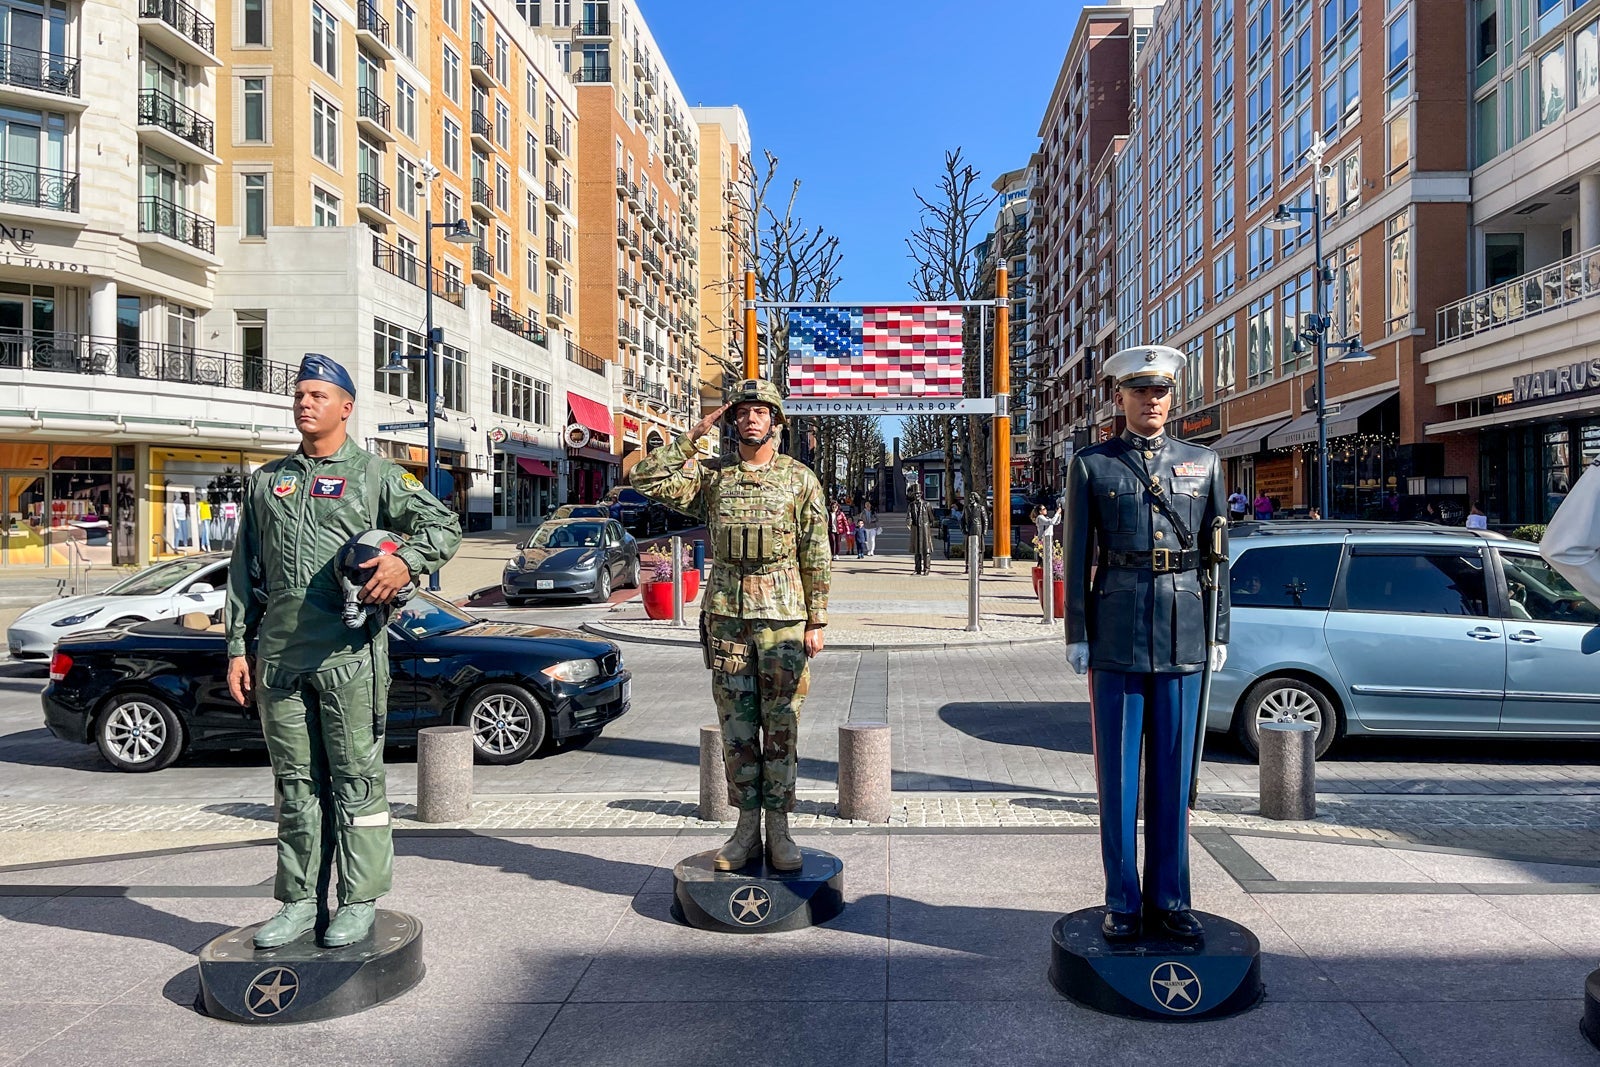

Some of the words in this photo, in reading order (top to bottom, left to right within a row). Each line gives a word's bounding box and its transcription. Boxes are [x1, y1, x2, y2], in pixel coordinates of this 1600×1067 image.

[24, 258, 89, 273] HARBOR
[1497, 393, 1513, 406] THE
[1513, 358, 1600, 402] WALRUS
[795, 403, 872, 412] NATIONAL
[896, 403, 957, 411] HARBOR
